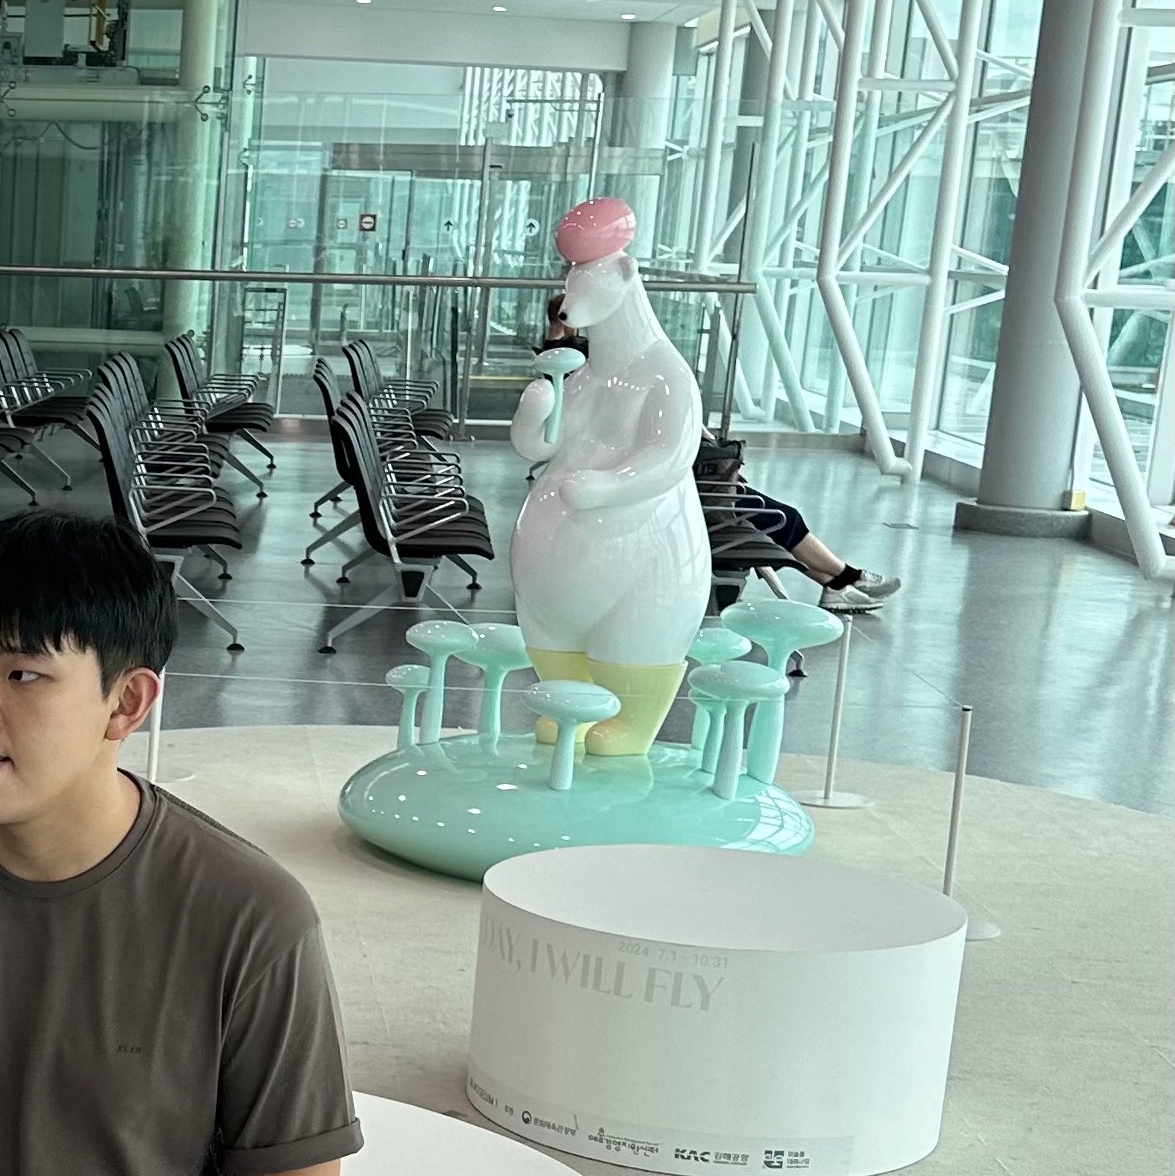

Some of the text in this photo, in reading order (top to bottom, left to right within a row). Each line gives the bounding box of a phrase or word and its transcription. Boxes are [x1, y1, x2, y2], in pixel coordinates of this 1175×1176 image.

[617, 941, 650, 958] 2024
[692, 953, 730, 968] 10.31
[530, 937, 539, 974] I
[546, 942, 633, 999] WILL
[644, 966, 725, 1011] FLY
[674, 1148, 711, 1163] KAC
